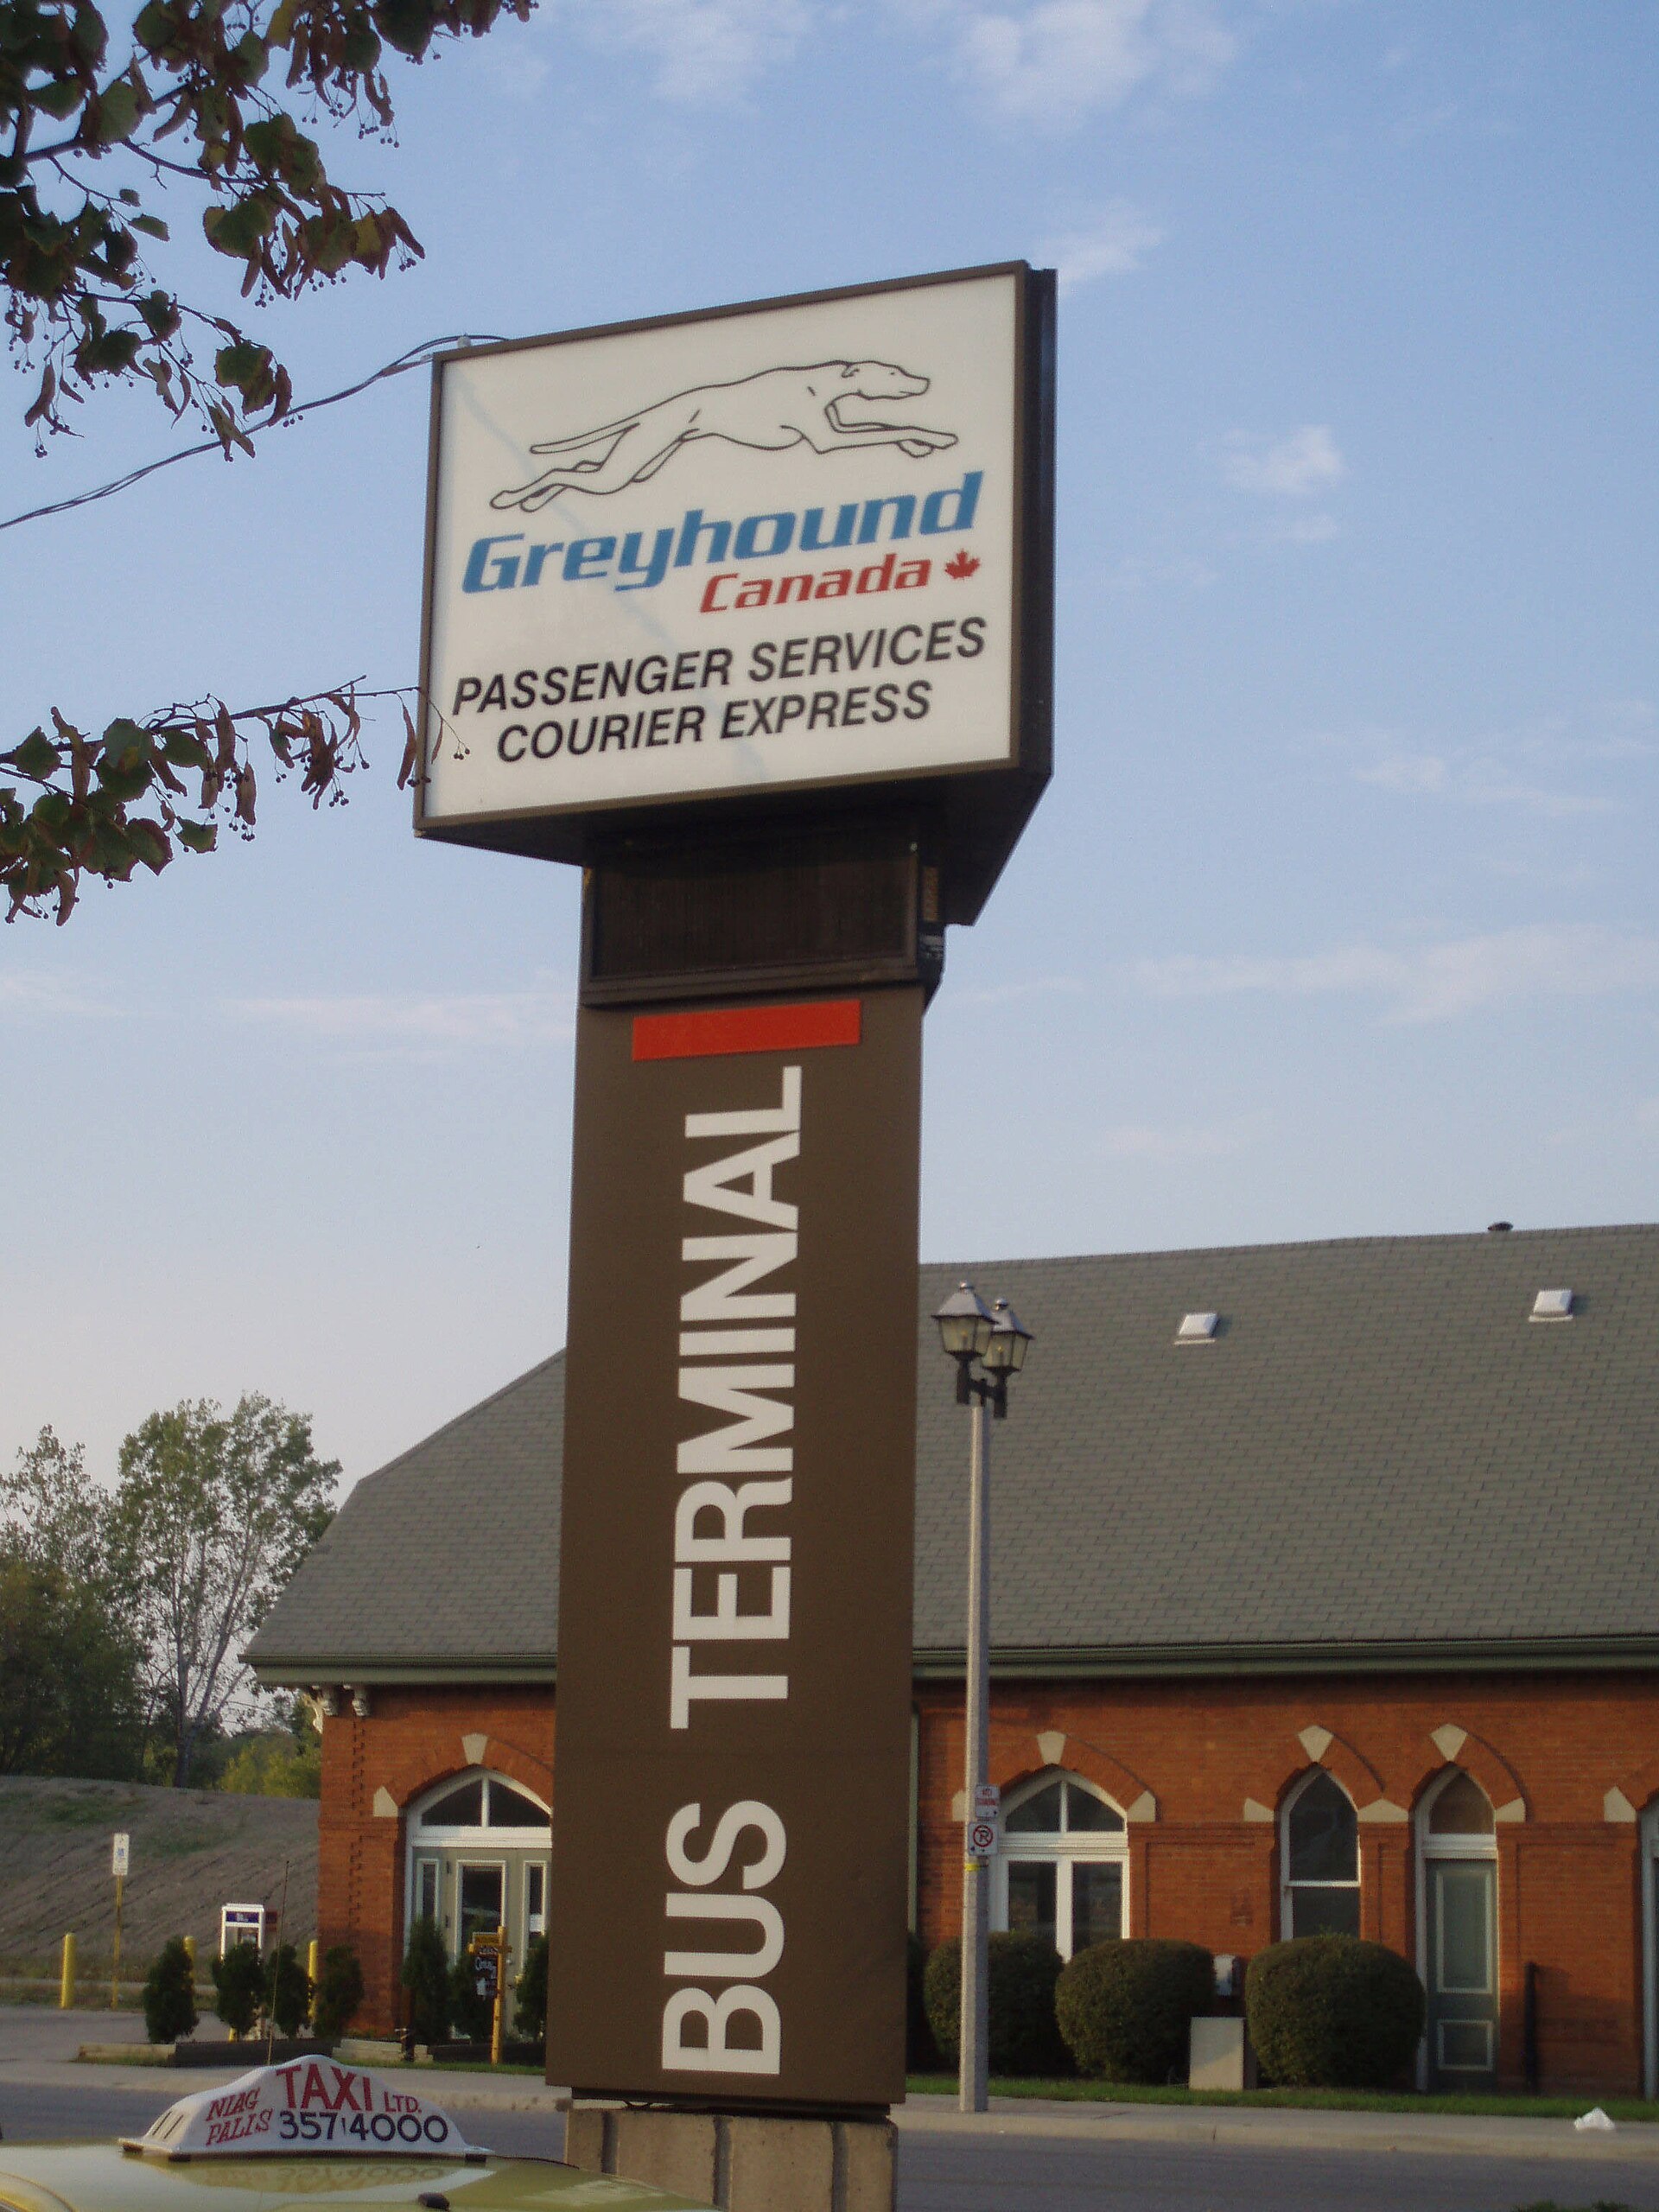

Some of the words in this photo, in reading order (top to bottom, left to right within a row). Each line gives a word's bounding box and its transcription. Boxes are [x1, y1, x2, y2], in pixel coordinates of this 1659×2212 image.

[461, 469, 984, 594] Greyhound
[699, 552, 932, 614] Canada
[452, 648, 733, 715] PASSENGER
[747, 616, 987, 684] SERVICES
[497, 705, 706, 763] COURIER
[719, 680, 934, 741] EXPRESS
[670, 1065, 802, 1730] TERMINAL
[661, 1799, 788, 2076] BUS
[206, 2087, 260, 2122] NIAG
[206, 2107, 274, 2146] FALLS
[276, 2063, 373, 2112] TAXI
[384, 2091, 423, 2113] LTD.
